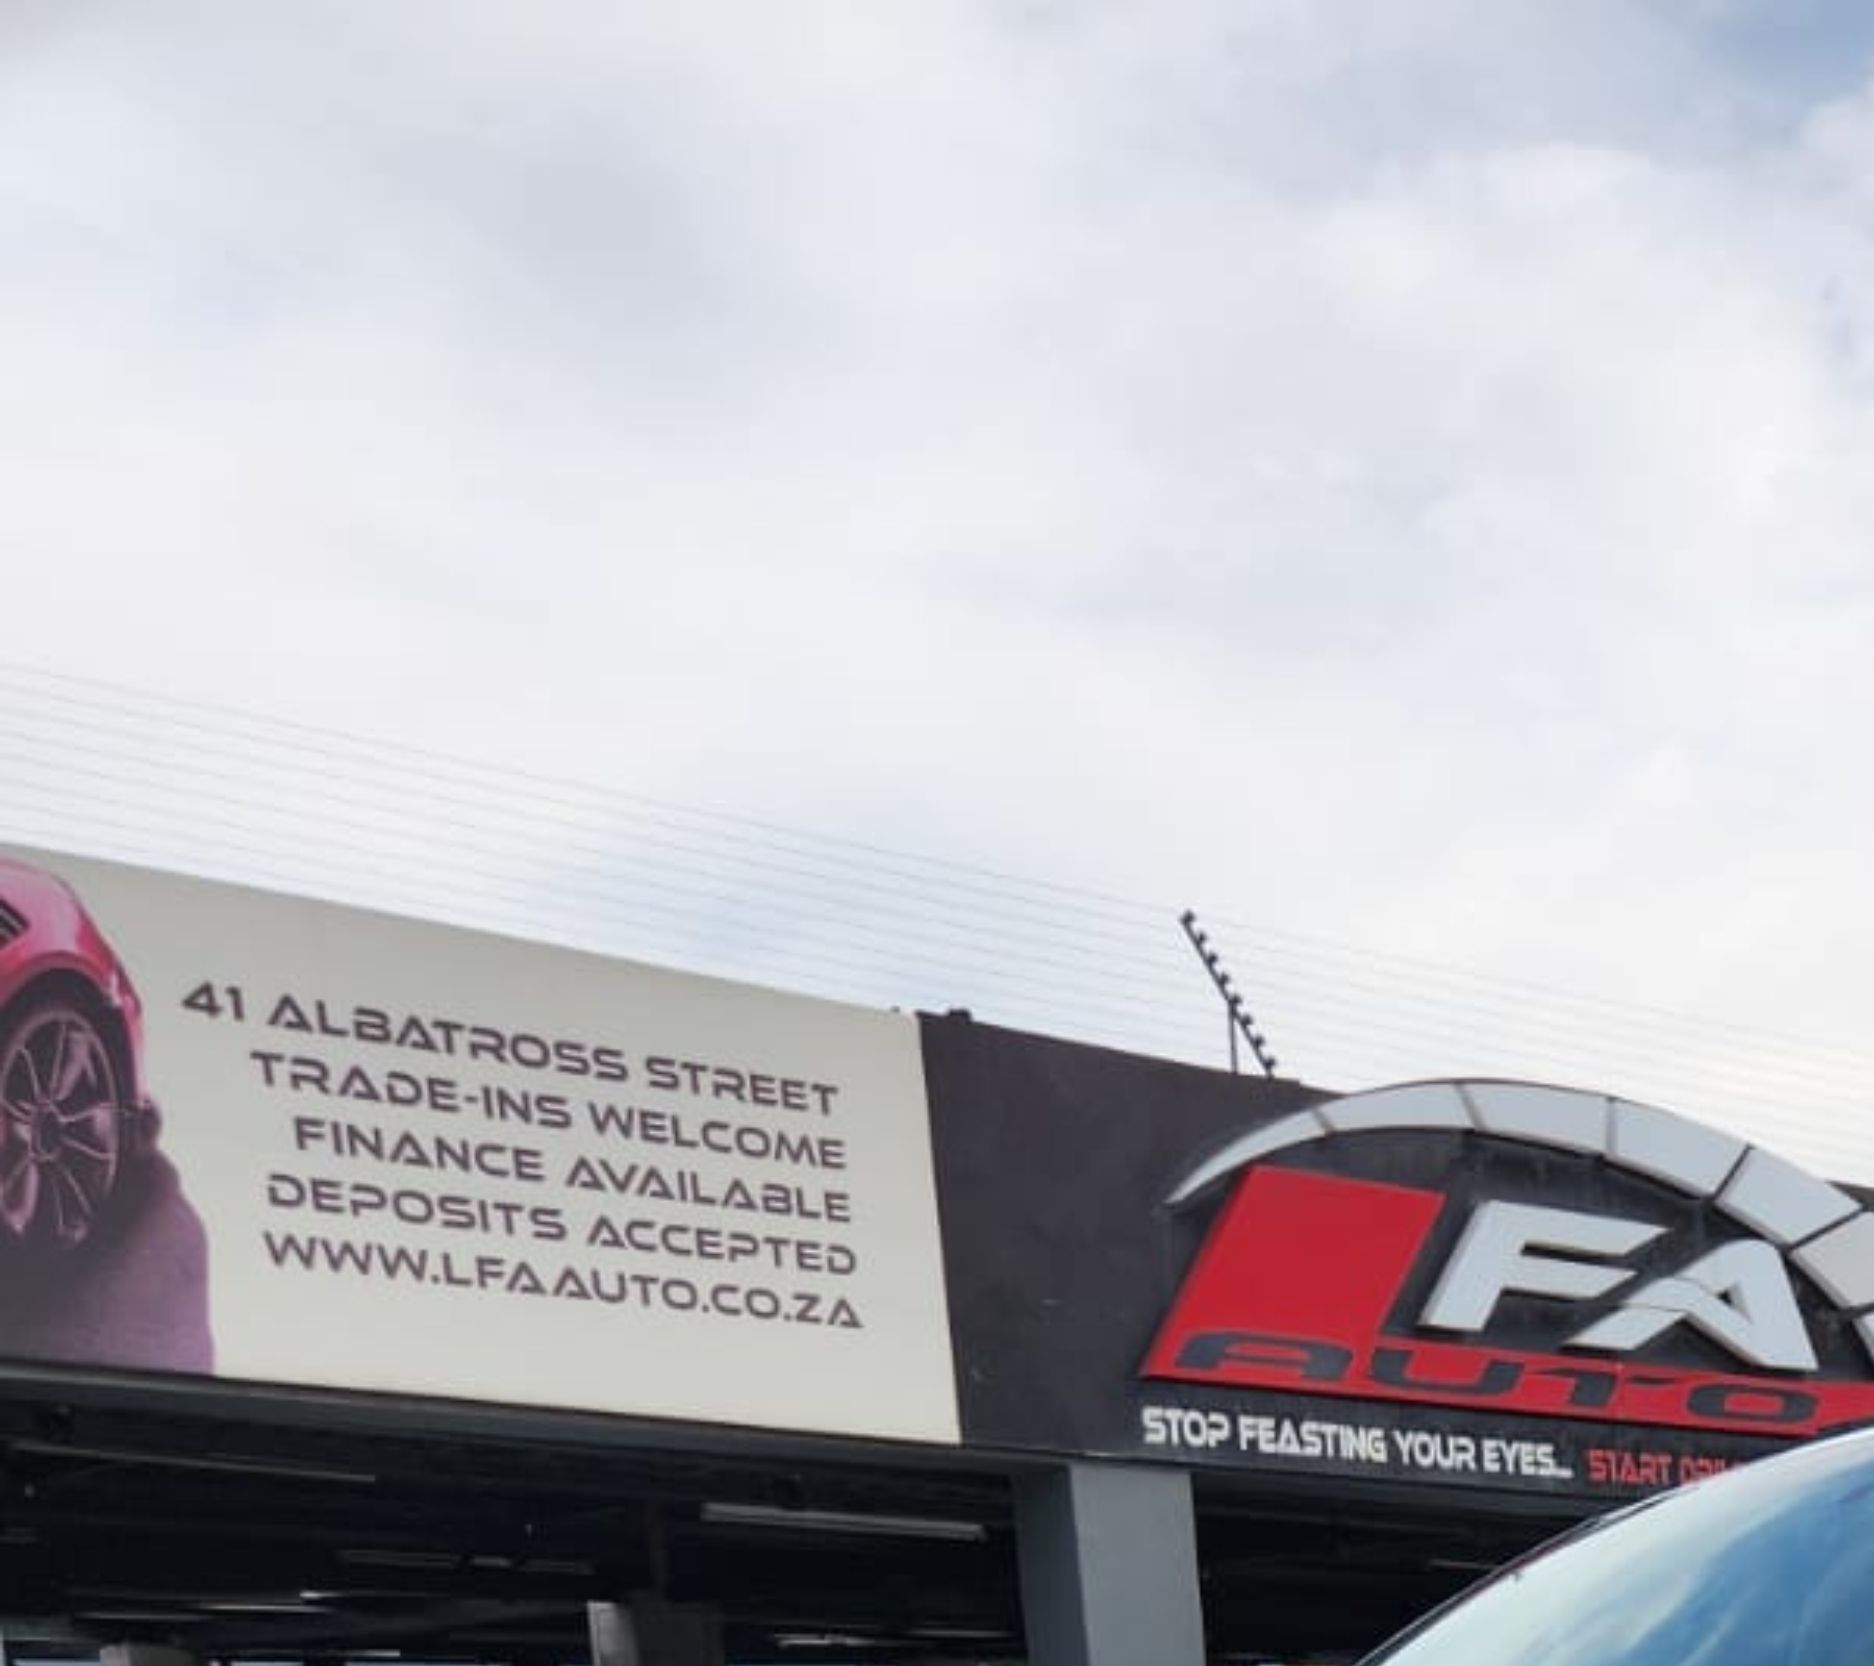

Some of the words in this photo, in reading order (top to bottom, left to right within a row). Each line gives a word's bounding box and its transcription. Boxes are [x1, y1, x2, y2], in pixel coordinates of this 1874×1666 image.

[180, 982, 247, 1022] 41
[266, 994, 629, 1083] ALBATROSS
[646, 1058, 840, 1117] STREET
[249, 1050, 572, 1129] TRADE-INS
[588, 1102, 848, 1171] WELCOME
[293, 1117, 545, 1183] FINANCE
[565, 1156, 852, 1224] AVAILABLE
[267, 1173, 567, 1242] DEPOSITS
[585, 1215, 858, 1277] ACCEPTED
[263, 1230, 863, 1330] WWW.LFAAUTO.CO.ZA
[1174, 1330, 1818, 1426] AUTO
[1142, 1406, 1231, 1449] STOP
[1238, 1414, 1387, 1463] FEASTING
[1394, 1429, 1477, 1471] YOUR
[1588, 1448, 1672, 1486] START
